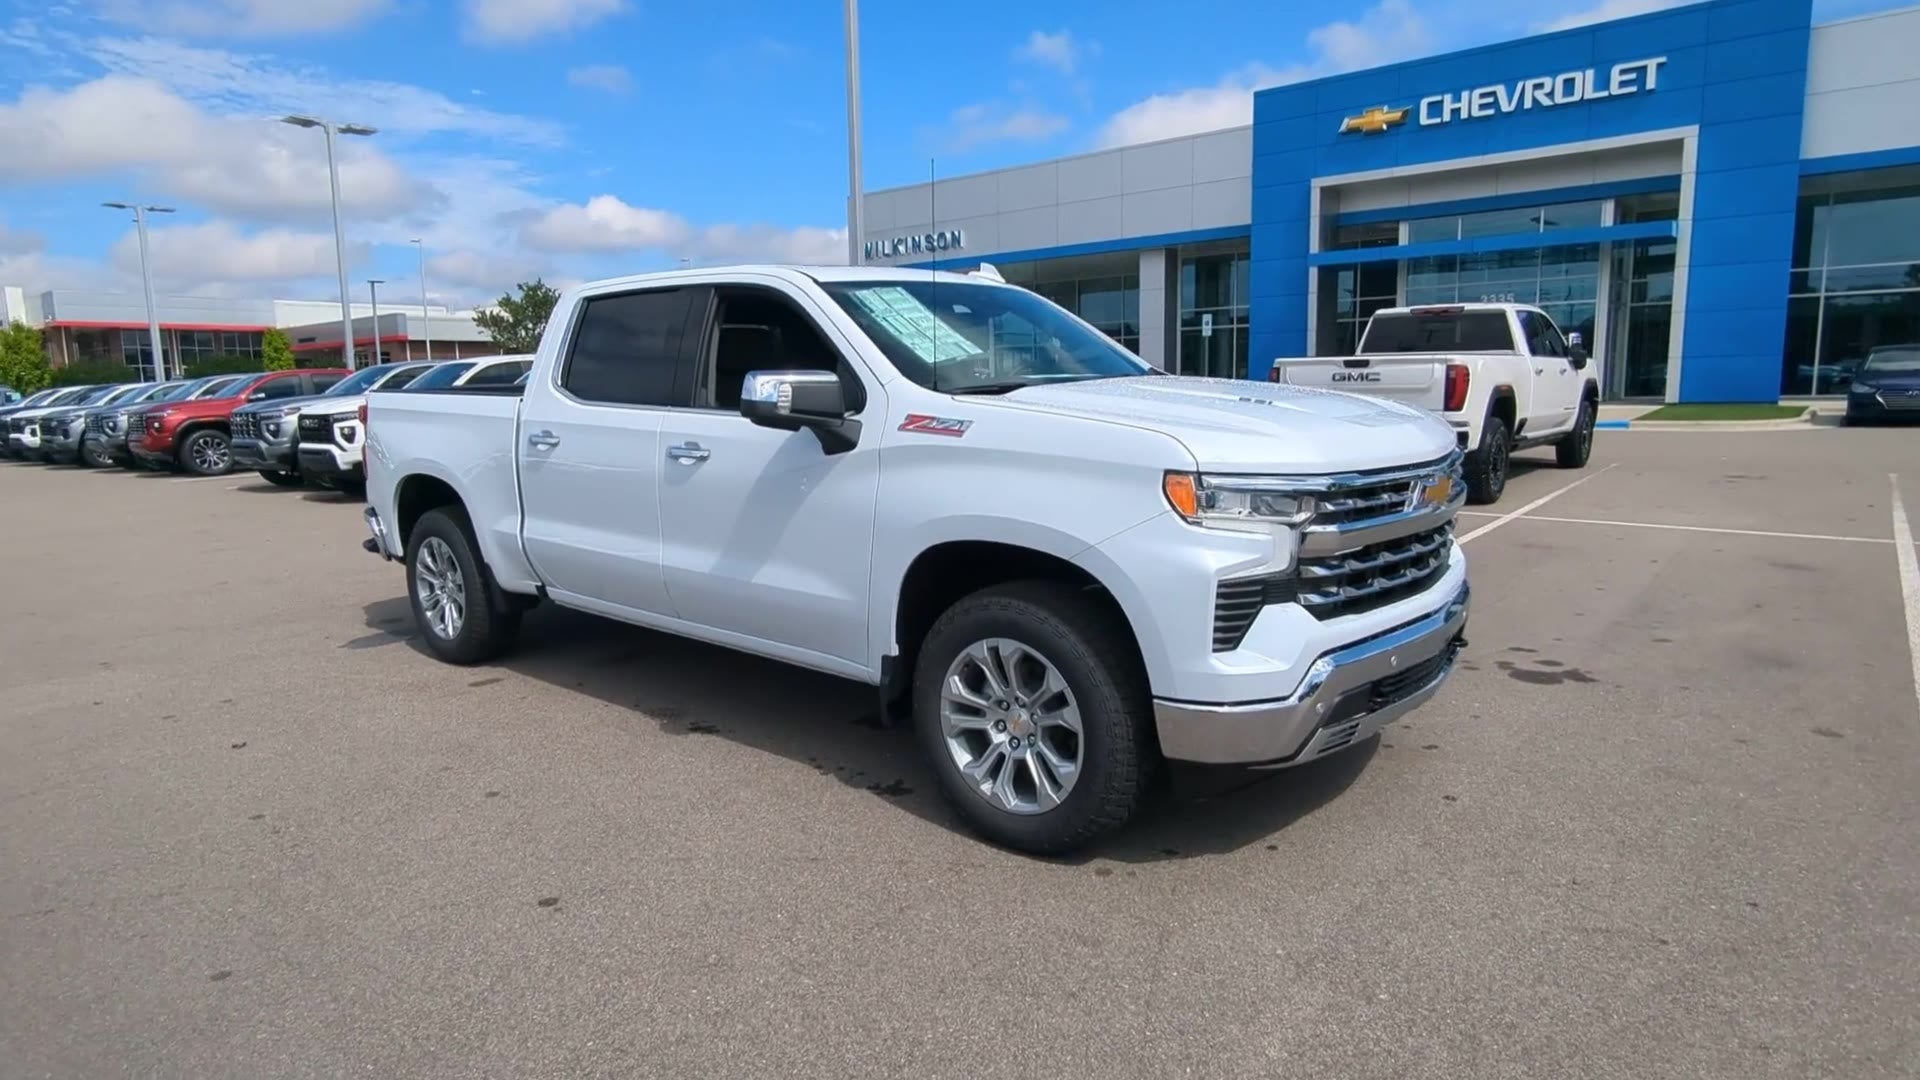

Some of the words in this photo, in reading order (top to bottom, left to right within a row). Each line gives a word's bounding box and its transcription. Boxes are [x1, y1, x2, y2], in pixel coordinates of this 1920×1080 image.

[1420, 56, 1667, 126] CHEVROLET
[1332, 371, 1380, 383] GMC
[897, 413, 972, 436] Z71
